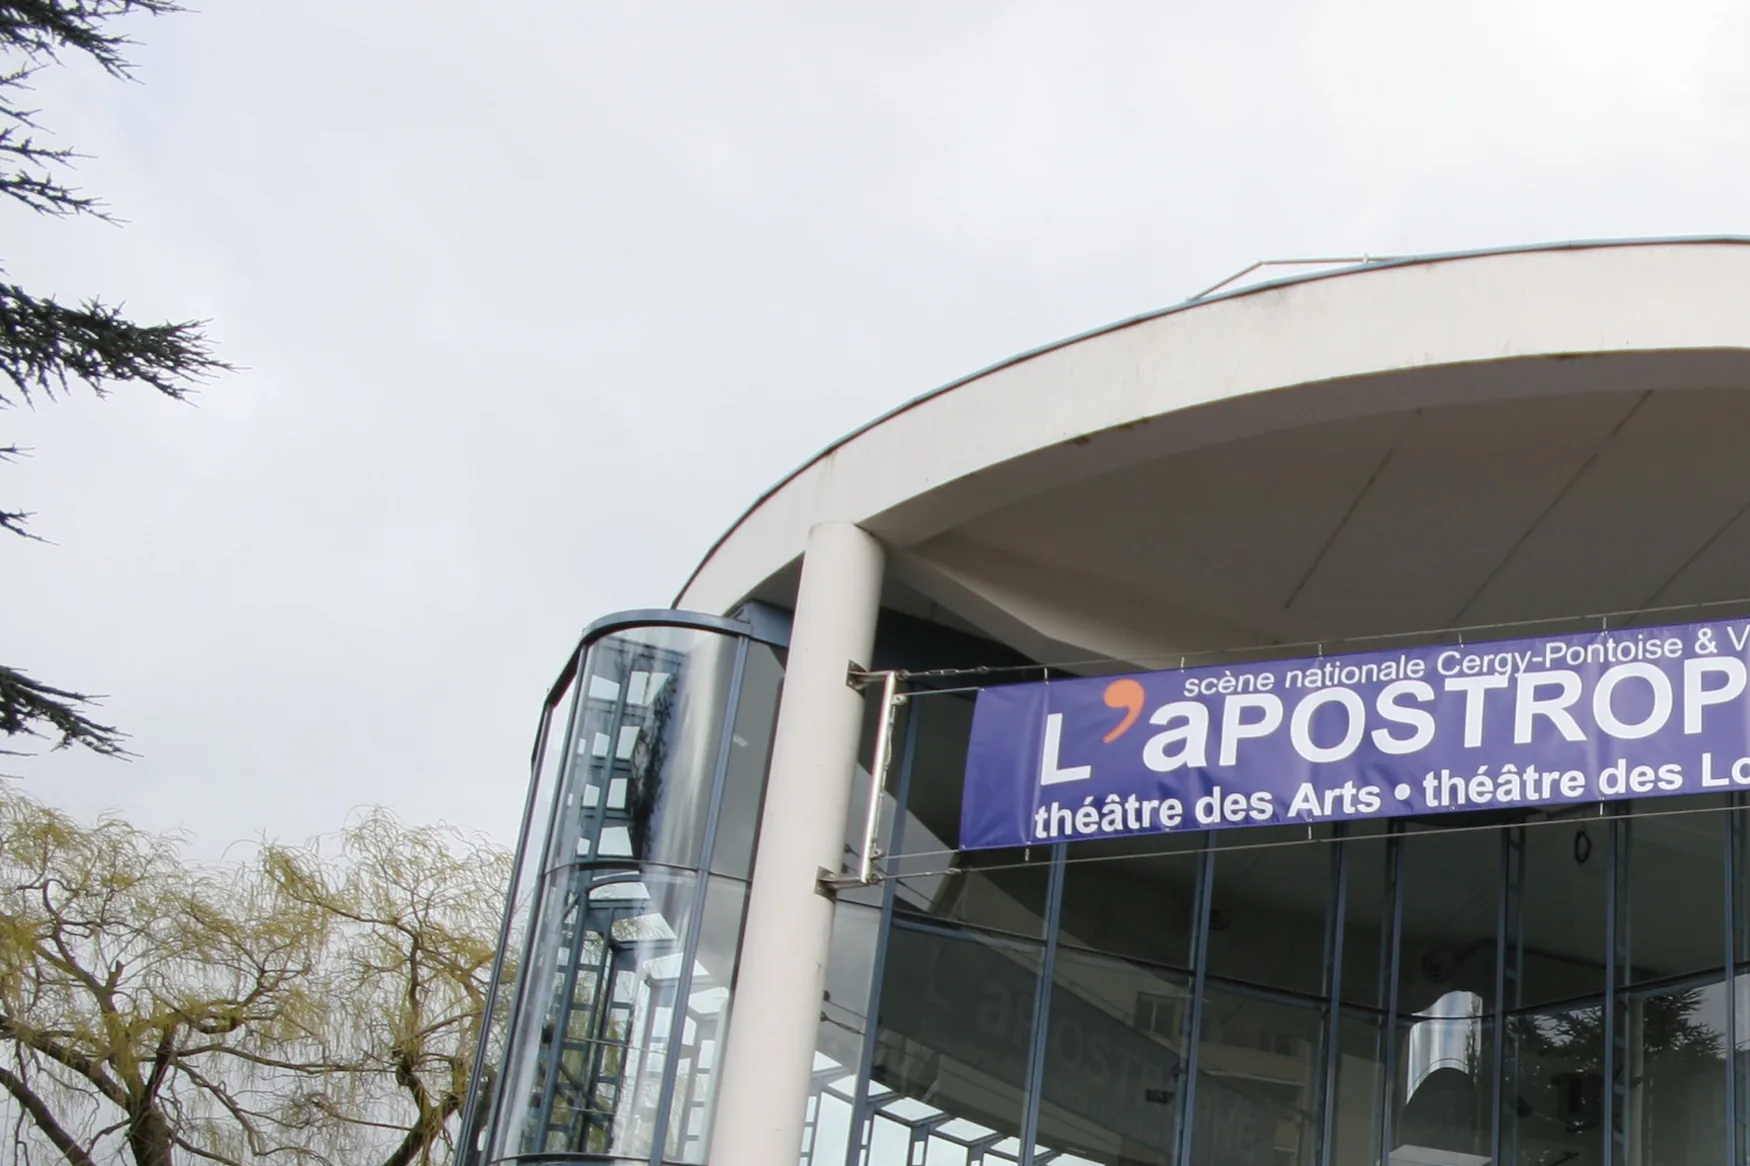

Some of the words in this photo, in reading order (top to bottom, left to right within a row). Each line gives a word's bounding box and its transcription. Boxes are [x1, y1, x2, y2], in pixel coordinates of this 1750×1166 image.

[1183, 671, 1275, 697] scène
[1284, 655, 1425, 689] nationale
[1437, 634, 1683, 677] Cergy-Pontoise
[1694, 628, 1718, 654] &
[1035, 794, 1183, 839] théâtre
[1195, 786, 1273, 824] des
[1287, 780, 1381, 817] Arts
[1422, 763, 1586, 809] théâtre
[1598, 758, 1683, 796] des
